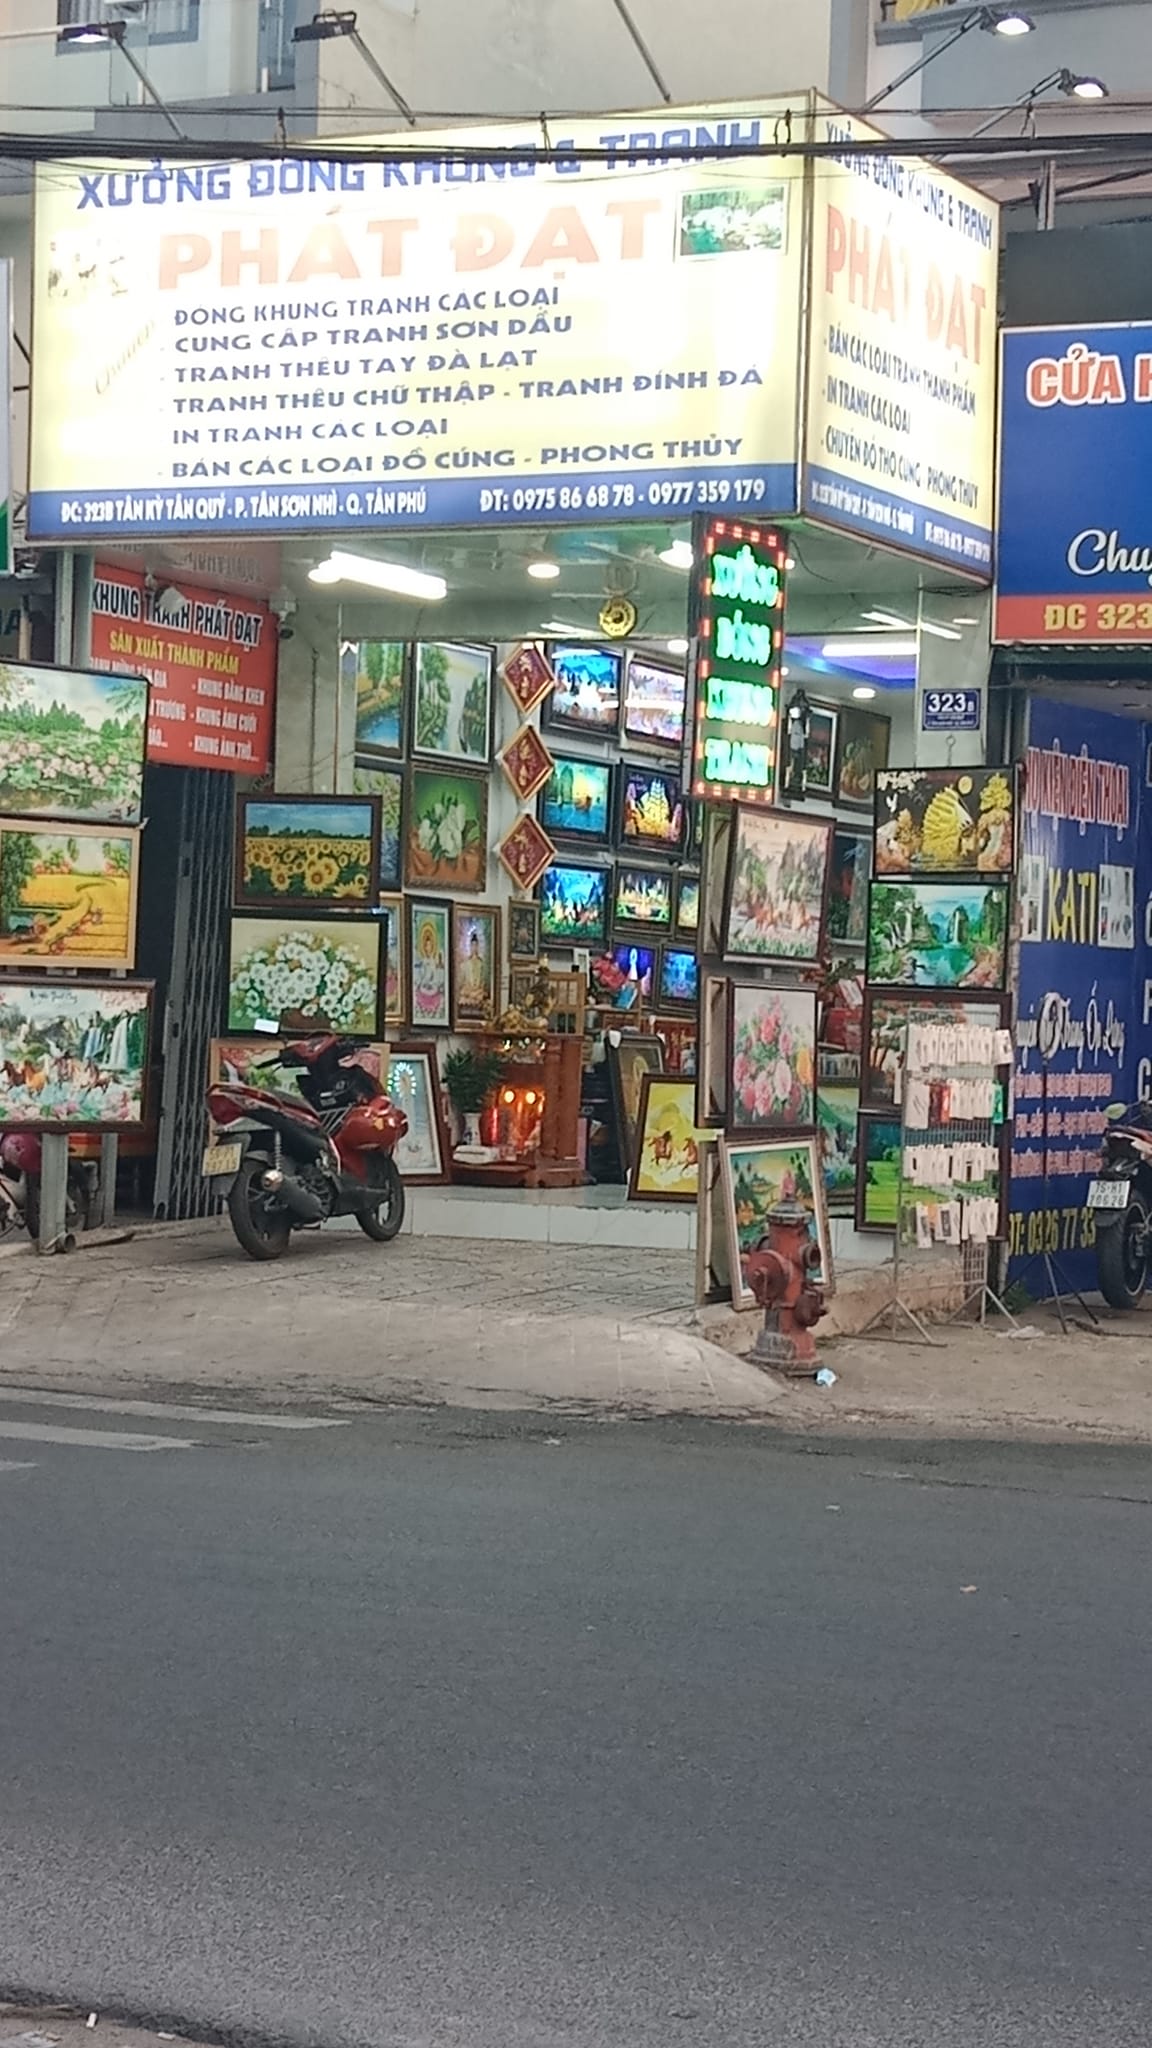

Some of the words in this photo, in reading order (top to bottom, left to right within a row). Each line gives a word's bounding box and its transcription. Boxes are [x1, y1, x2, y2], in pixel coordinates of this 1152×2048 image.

[77, 158, 231, 210] XƯỞNG
[600, 121, 760, 170] TRANH
[159, 204, 418, 291] PHÁT
[450, 198, 661, 279] ĐẠT
[254, 300, 338, 322] KHUNG
[347, 294, 430, 316] TRANH
[494, 286, 559, 310] LOẠI
[175, 334, 252, 353] CUNG
[326, 324, 427, 346] TRANH
[436, 320, 498, 340] SƠN
[174, 364, 271, 383] TRANH
[279, 356, 351, 378] THÊU
[359, 356, 416, 375] TAY
[427, 348, 470, 371] ĐÀ
[480, 349, 537, 372] LẠT
[1027, 344, 1126, 407] CỬA
[173, 395, 267, 414] TRANH
[275, 387, 345, 409] THÊU
[353, 384, 409, 406] CHỮ
[416, 380, 495, 406] THẬP
[519, 376, 623, 399] TRANH
[632, 370, 708, 391] ĐÍNH
[717, 364, 763, 388] ĐÁ
[173, 429, 199, 444] IN
[208, 425, 302, 443] TRANH
[375, 418, 448, 440] LOẠI
[172, 457, 231, 477] BÁN
[239, 455, 293, 476] CÁC
[435, 446, 515, 470] CÚNG
[541, 442, 654, 465] PHONG
[663, 432, 743, 459] THỦY
[115, 493, 143, 522] TÂN
[166, 492, 194, 521] TÂN
[196, 491, 226, 520] QUÝ
[235, 496, 249, 519] P.
[250, 489, 279, 518] TÂN
[346, 492, 363, 516] Q.
[365, 486, 396, 515] TÂN
[397, 485, 427, 514] PHÚ
[480, 490, 508, 513] ĐT:
[512, 488, 555, 512] 0975
[559, 486, 582, 510] 86
[586, 485, 609, 509] 68
[612, 484, 635, 507] 78
[648, 481, 694, 505] 0977
[697, 480, 731, 503] 359
[733, 478, 766, 502] 179
[1044, 604, 1086, 631] ĐC
[1047, 867, 1097, 944] KATI
